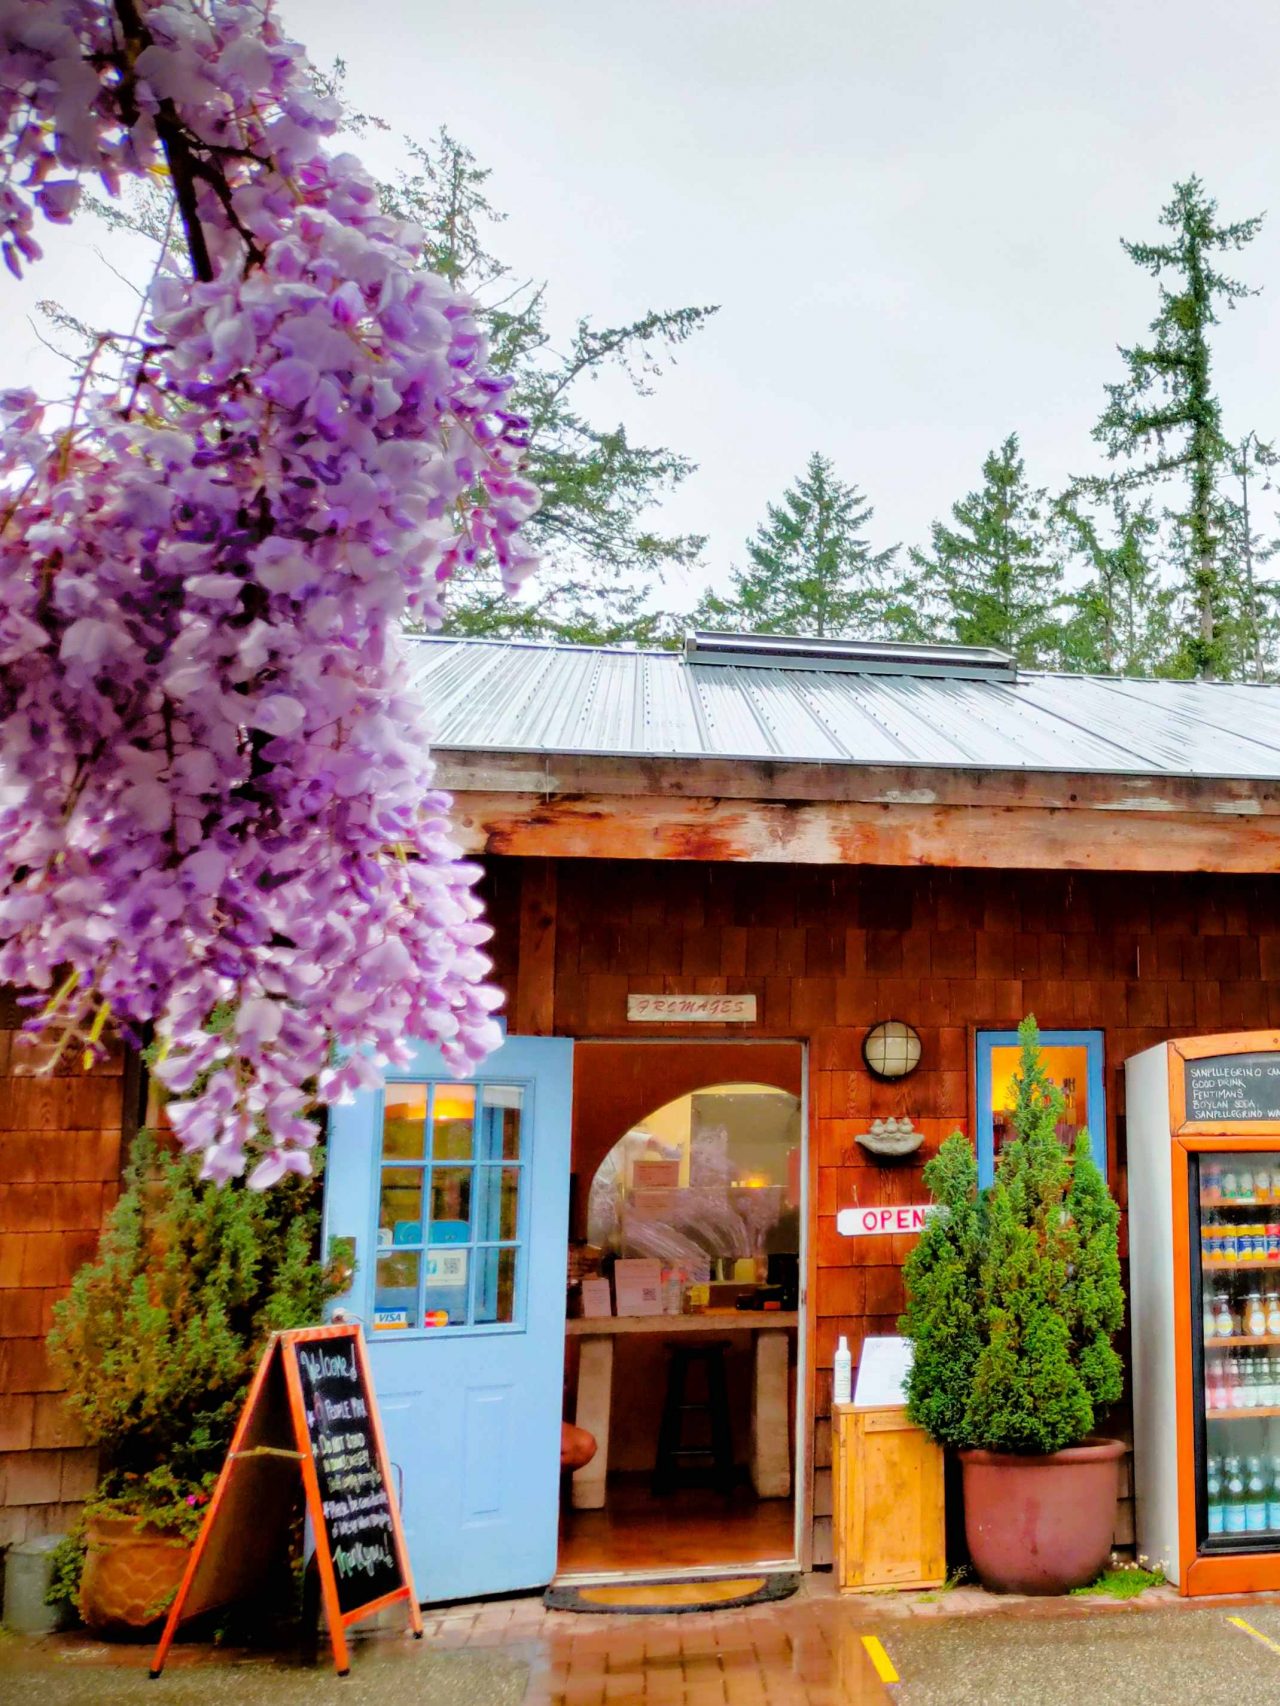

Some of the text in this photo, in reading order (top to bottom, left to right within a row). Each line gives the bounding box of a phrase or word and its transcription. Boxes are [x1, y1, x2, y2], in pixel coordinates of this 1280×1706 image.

[1191, 1079, 1215, 1089] GOOD
[1217, 1078, 1247, 1088] DRINK
[1193, 1089, 1244, 1100] FENTIMANS
[1193, 1100, 1229, 1110] BOYLAN
[862, 1209, 926, 1231] OPEN
[379, 1313, 402, 1322] VISA
